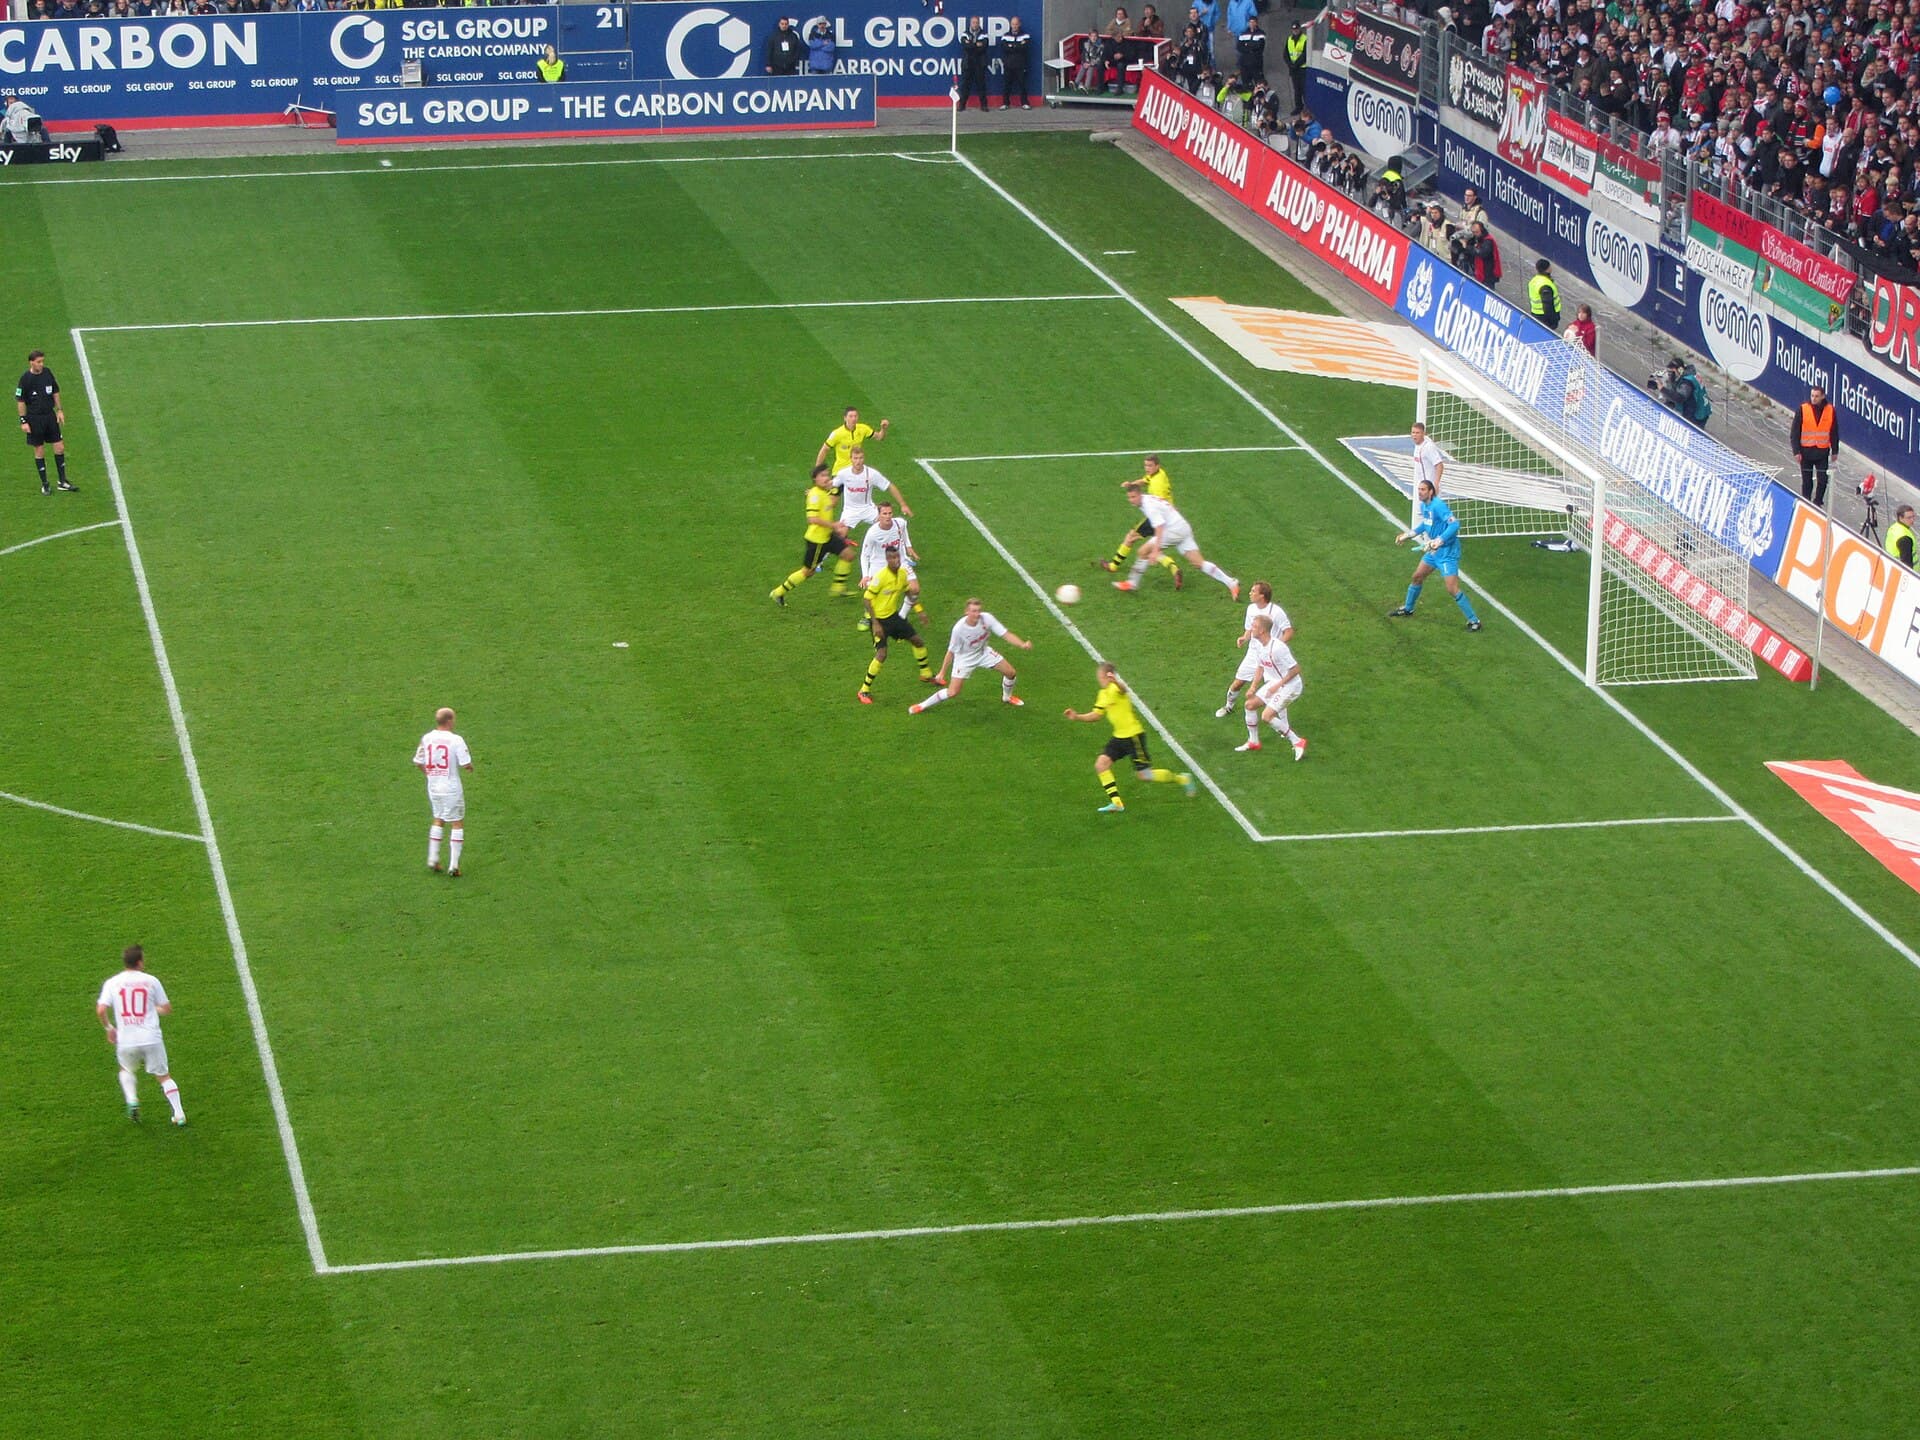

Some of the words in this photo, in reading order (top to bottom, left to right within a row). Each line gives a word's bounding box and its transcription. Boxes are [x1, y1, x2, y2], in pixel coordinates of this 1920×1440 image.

[402, 20, 449, 42] SGL
[456, 17, 548, 39] GROUP
[596, 7, 623, 28] 21
[0, 22, 257, 74] CARBON
[403, 47, 426, 59] THE
[428, 45, 481, 58] CARBON
[484, 43, 547, 57] COMPANY
[375, 75, 391, 84] SGL
[436, 74, 452, 82] SGL
[454, 72, 484, 81] GROUP
[498, 72, 514, 80] SGL
[832, 58, 904, 76] ARBON
[1, 88, 17, 96] SGL
[18, 86, 49, 96] GROUP
[63, 86, 79, 94] SGL
[80, 84, 112, 94] GROUP
[126, 83, 141, 92] SGL
[143, 82, 174, 92] GROUP
[188, 81, 204, 90] SGL
[205, 80, 236, 89] GROUP
[251, 79, 267, 88] SGL
[268, 78, 298, 87] GROUP
[313, 77, 328, 86] SGL
[331, 76, 360, 85] GROUP
[358, 102, 413, 126] SGL
[423, 98, 530, 124] GROUP
[560, 96, 606, 119] THE
[615, 91, 724, 118] CARBON
[732, 87, 862, 116] COMPANY
[1353, 89, 1408, 141] roma
[49, 143, 82, 163] sky
[1185, 115, 1249, 189] PHARMA
[1444, 139, 1486, 193] Rollladen
[1495, 165, 1544, 225] Raffstoren
[1554, 203, 1580, 248] Textil
[1320, 203, 1397, 290] PHARMA
[1591, 219, 1642, 286] roma
[1675, 264, 1684, 292] 2
[1483, 294, 1512, 328] WODKA
[1706, 287, 1763, 359] roma
[1434, 283, 1548, 406] GORBATSCHOW
[1776, 337, 1829, 395] Rollladen
[1841, 375, 1904, 441] Raffstoren
[1657, 412, 1690, 449] WODKA
[1600, 397, 1737, 538] GORBATSCHOW
[426, 744, 449, 769] 13
[119, 987, 148, 1017] 10
